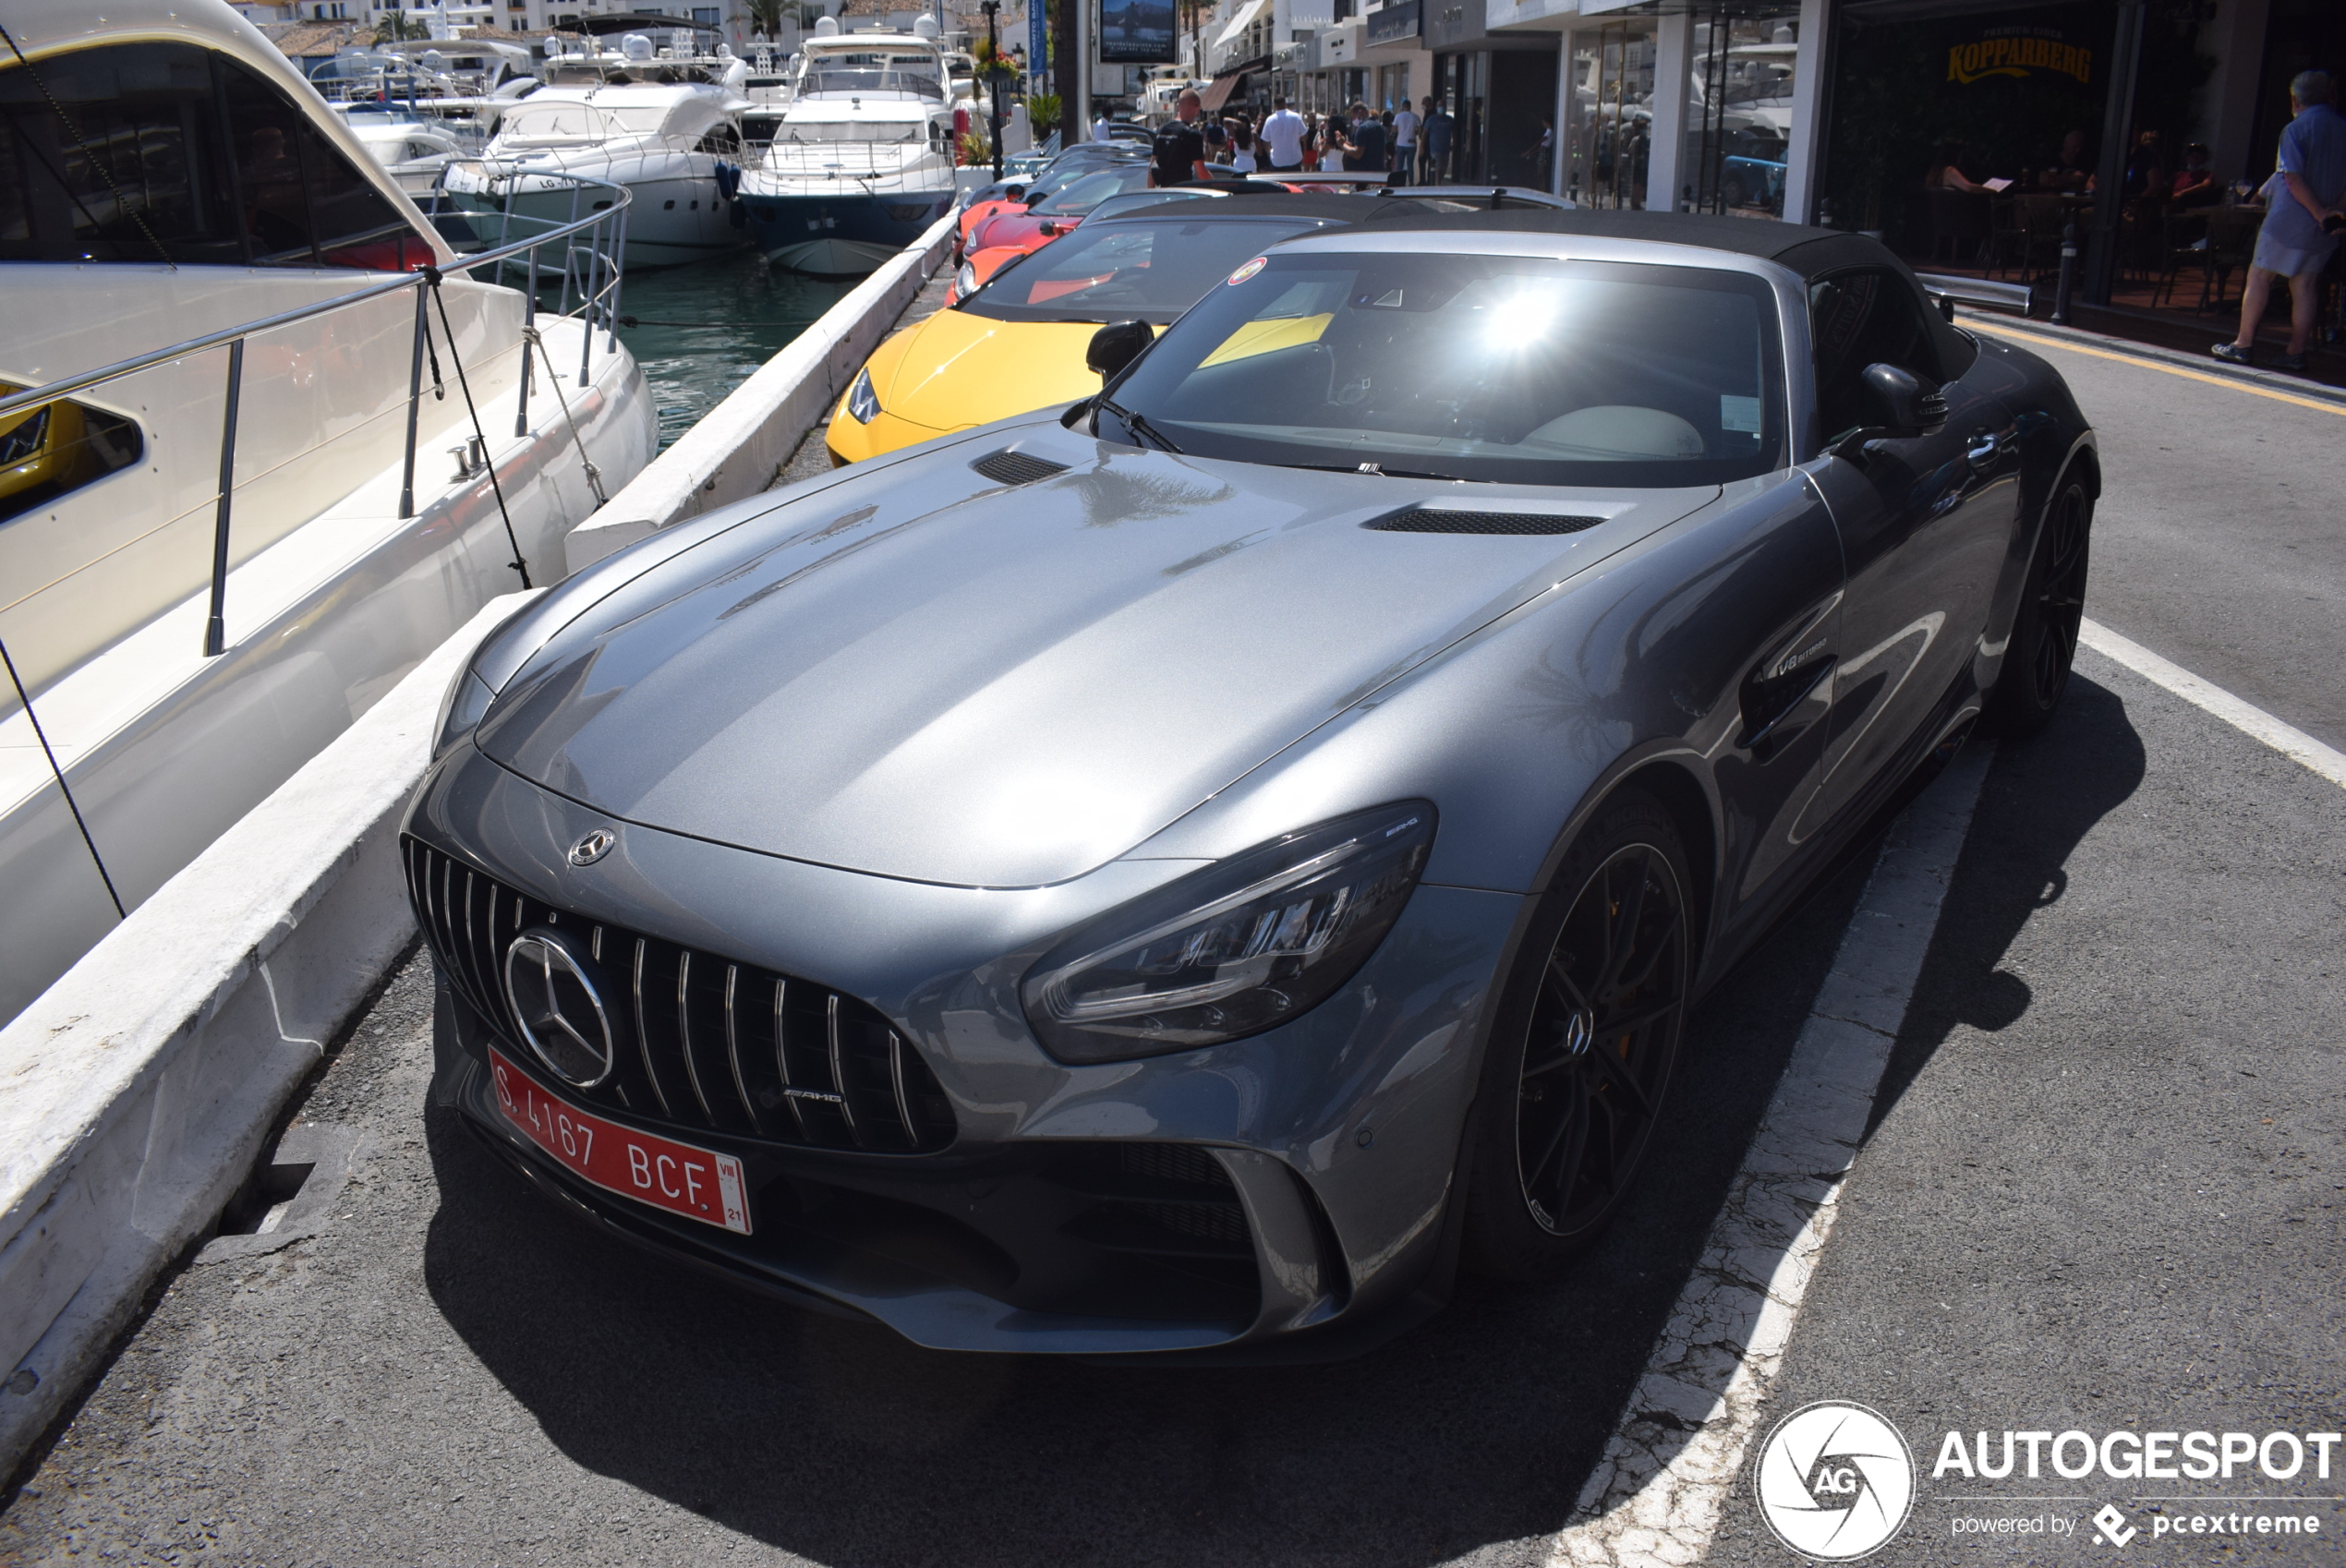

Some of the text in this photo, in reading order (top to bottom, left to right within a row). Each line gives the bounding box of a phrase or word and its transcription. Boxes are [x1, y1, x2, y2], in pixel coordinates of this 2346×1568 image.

[1946, 37, 2092, 85] KOPPARBERG
[1779, 637, 1827, 676] V8 BITURBO
[800, 1091, 842, 1104] AMG
[497, 1065, 706, 1205] S 4167 BCF
[720, 1162, 736, 1178] VIII
[728, 1208, 742, 1222] 21
